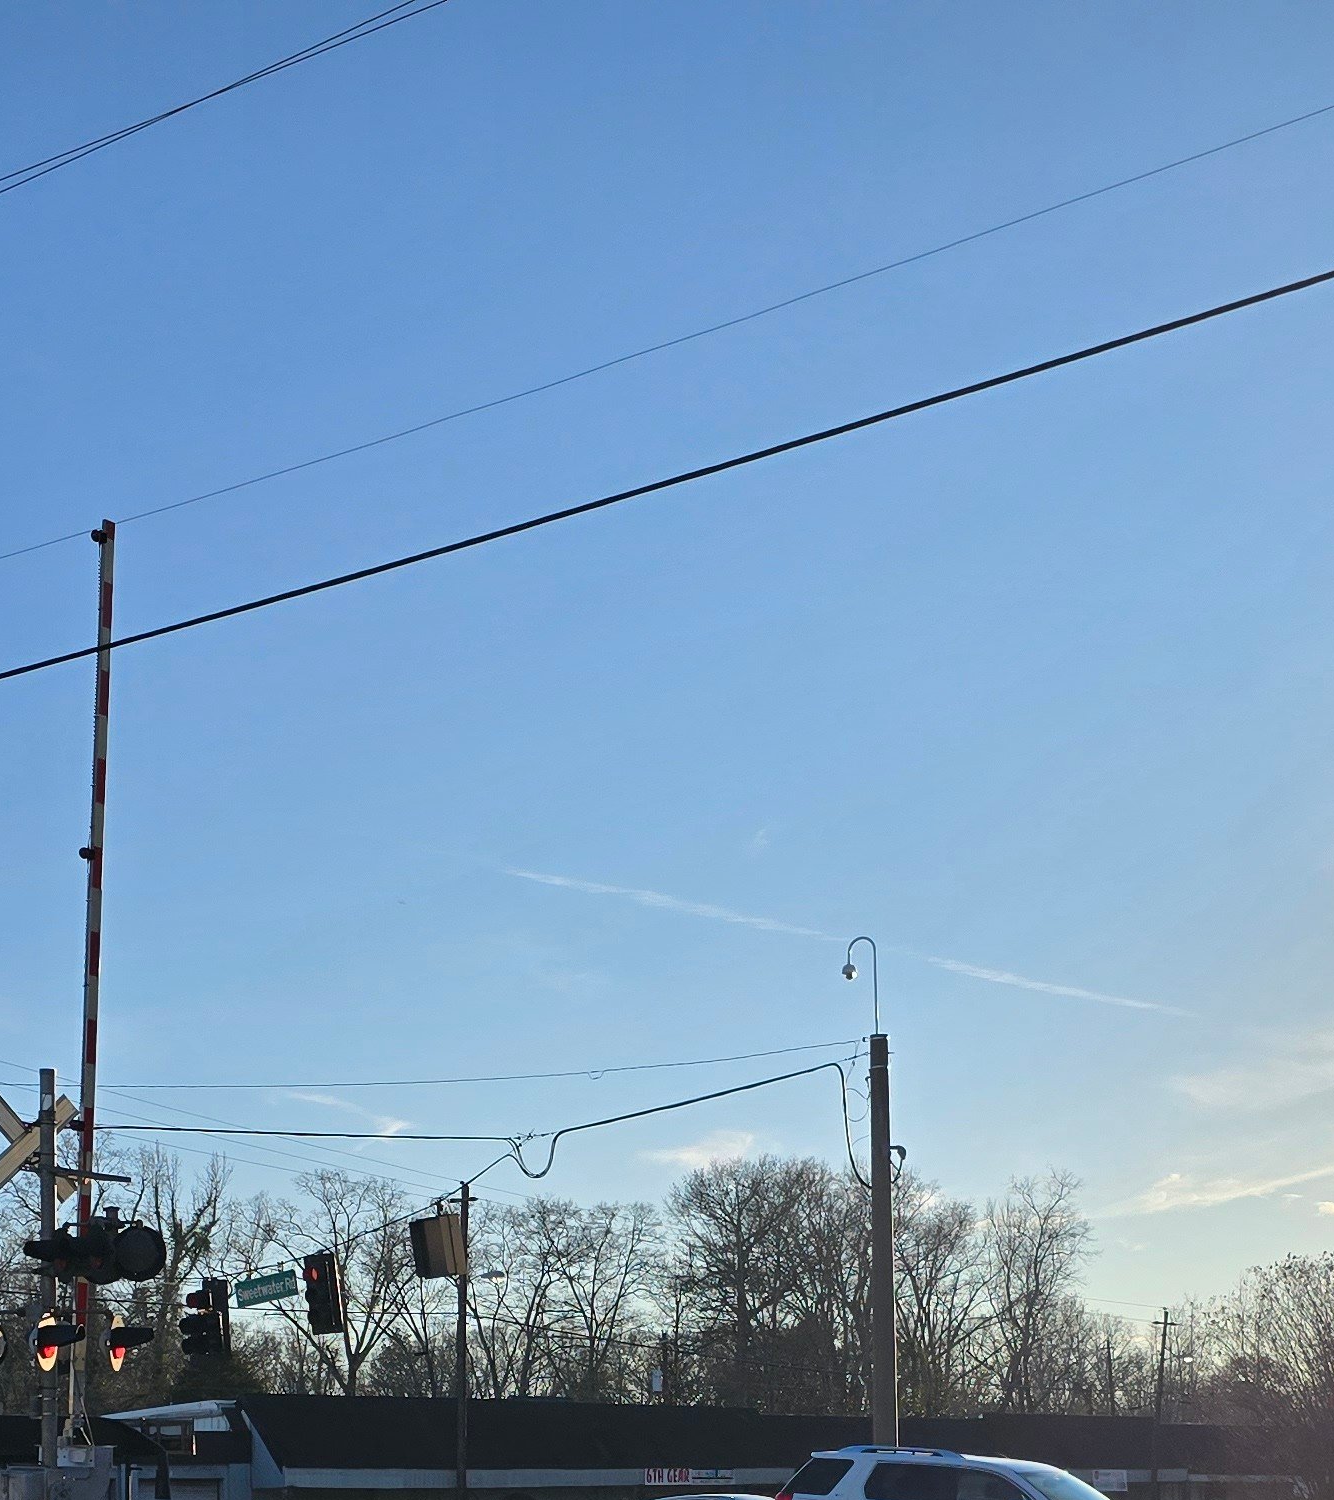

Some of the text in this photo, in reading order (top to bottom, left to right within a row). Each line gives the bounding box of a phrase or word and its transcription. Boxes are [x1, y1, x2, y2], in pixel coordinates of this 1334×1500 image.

[238, 1276, 297, 1302] Sweetwater Rd
[646, 1468, 664, 1484] 6TH
[667, 1468, 690, 1483] GEAR
